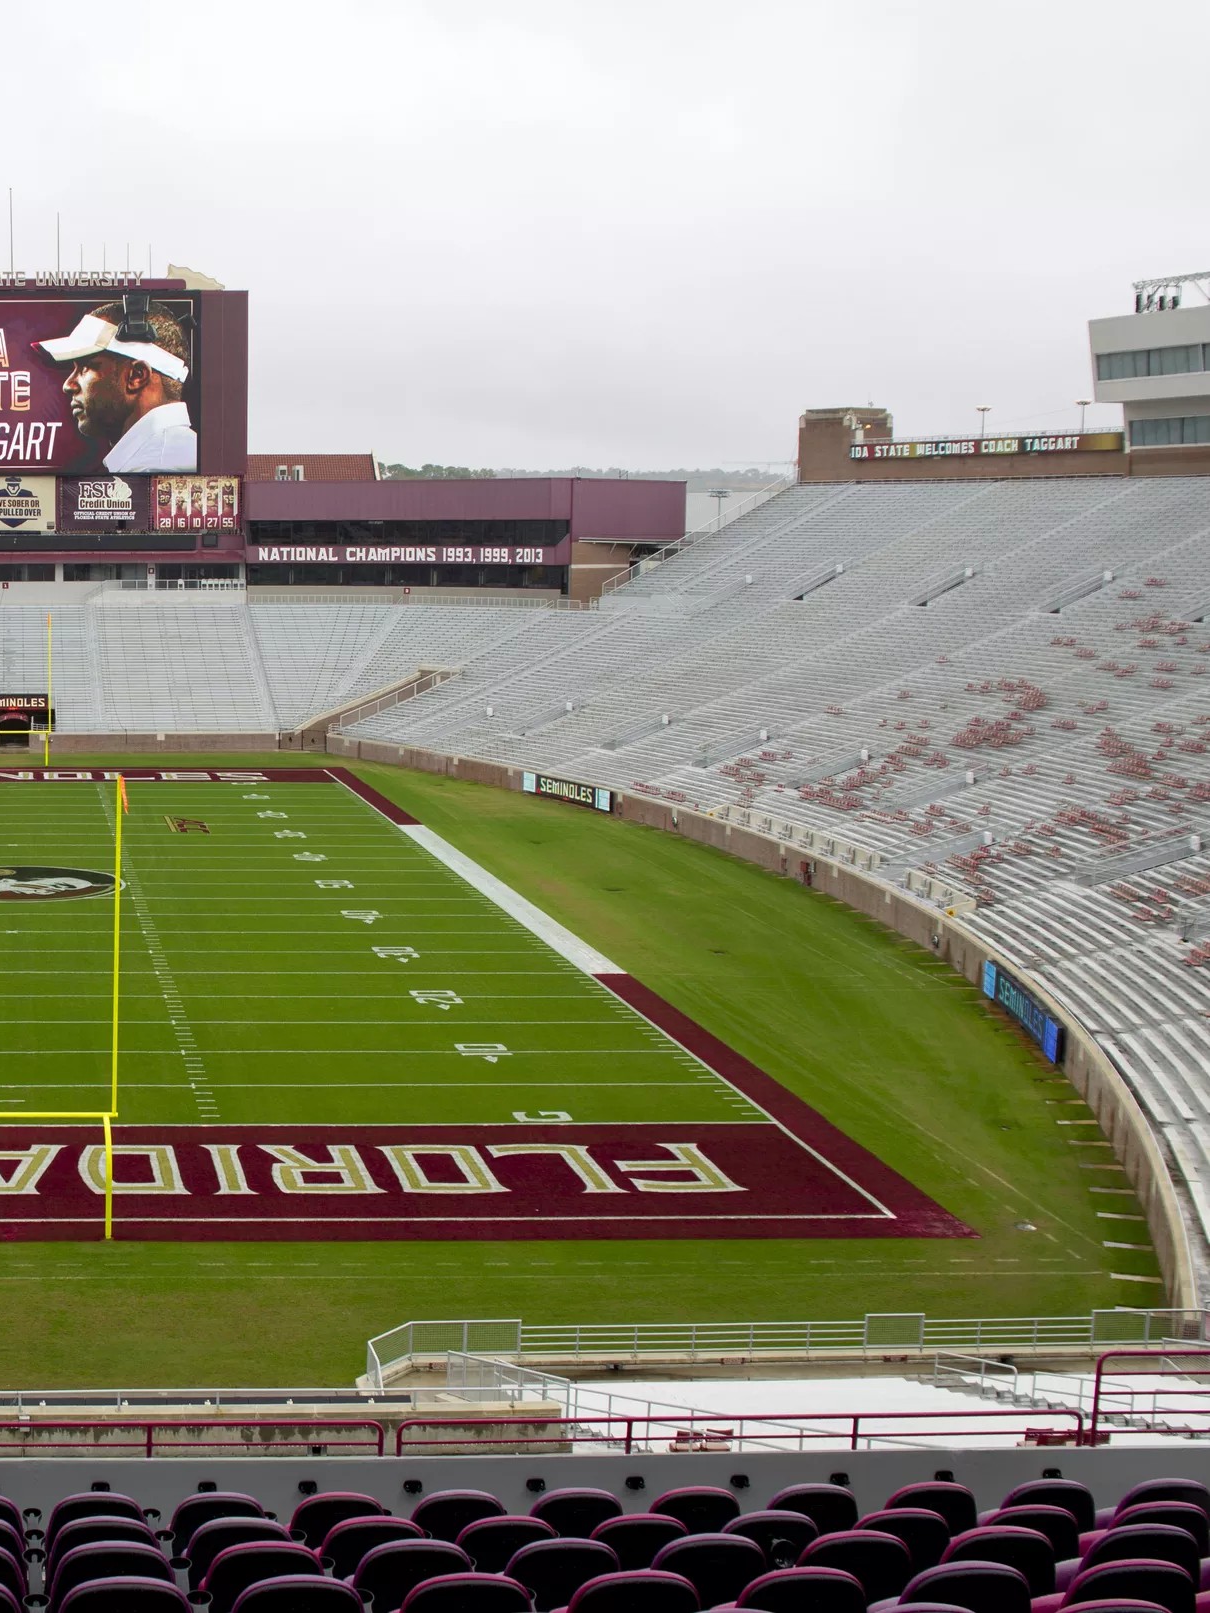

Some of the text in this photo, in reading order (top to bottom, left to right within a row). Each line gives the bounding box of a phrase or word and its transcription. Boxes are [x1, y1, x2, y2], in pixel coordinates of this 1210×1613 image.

[36, 270, 144, 287] UNIVERSITY
[874, 444, 910, 457] STATE
[916, 441, 975, 456] WELCOMES
[981, 439, 1018, 452] COACH
[1024, 436, 1080, 451] TAGGART
[78, 482, 116, 498] FSU
[80, 499, 130, 508] Credit Union
[160, 517, 233, 527] 28 16 10 27 55
[258, 547, 543, 564] NATIONAL CHAMPIONS 1993, 1999, 2013
[540, 777, 592, 803] SEMINOLES
[408, 990, 464, 1004] 20
[454, 1044, 514, 1056] 10
